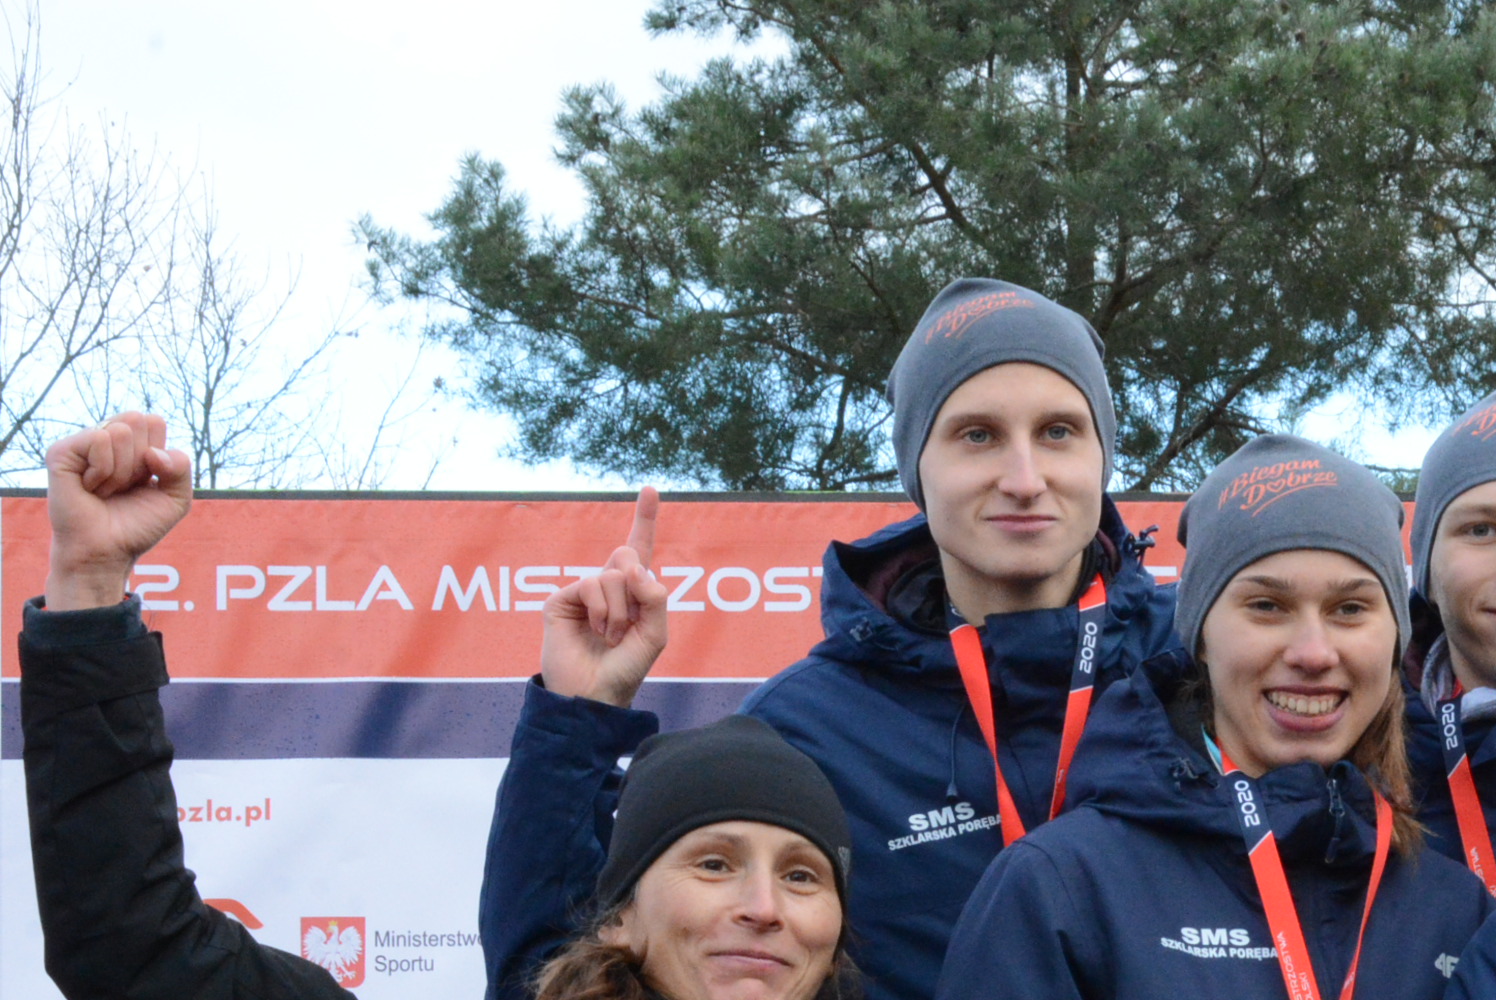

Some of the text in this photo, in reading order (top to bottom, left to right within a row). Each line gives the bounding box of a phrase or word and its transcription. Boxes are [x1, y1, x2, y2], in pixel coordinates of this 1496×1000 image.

[1218, 459, 1323, 510] #Biegam
[125, 564, 195, 612] 2.
[216, 564, 415, 612] PZLA
[1079, 621, 1098, 674] 2020
[1441, 703, 1459, 751] 2020
[908, 802, 975, 832] SMS
[1234, 780, 1261, 828] 2020
[888, 824, 957, 851] SZKLARSKA
[1161, 937, 1279, 961] SZKLARSKA PORĘBA
[1180, 927, 1250, 946] SMS
[374, 955, 435, 976] Sportu
